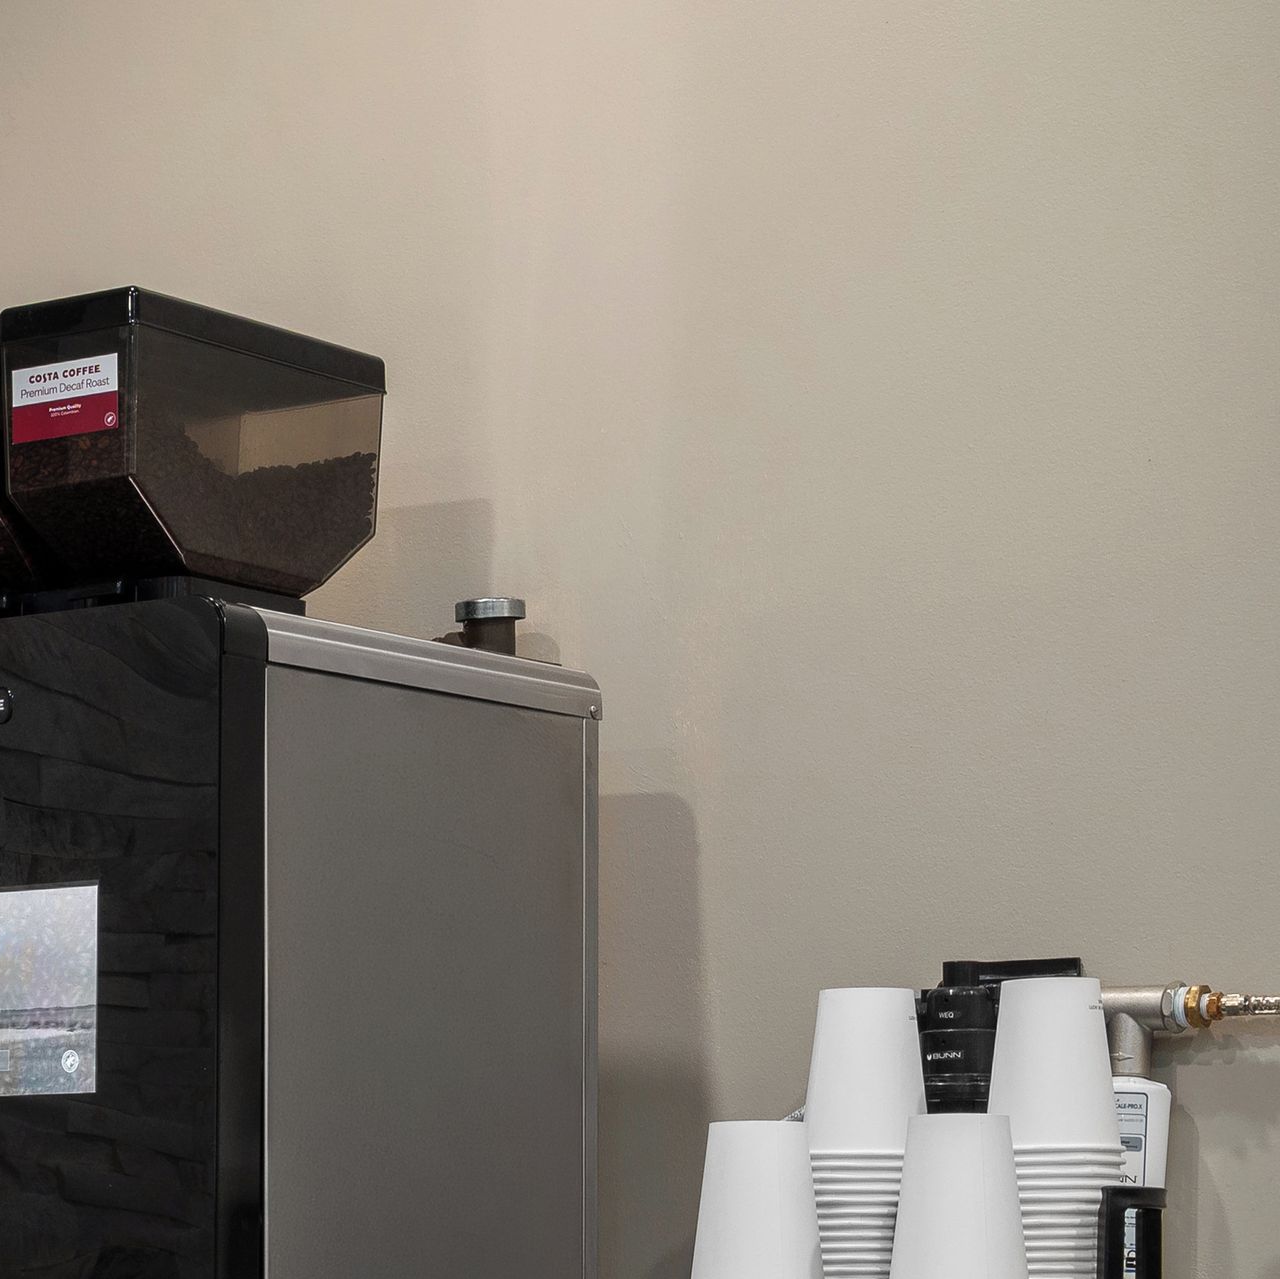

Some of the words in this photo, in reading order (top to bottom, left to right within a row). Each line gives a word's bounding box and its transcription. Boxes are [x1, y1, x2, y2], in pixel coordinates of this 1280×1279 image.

[29, 372, 60, 384] COSTA
[62, 364, 100, 378] COFFEE
[20, 386, 58, 399] Premium
[60, 379, 85, 393] Decaf
[86, 377, 110, 389] Roast
[932, 1052, 962, 1060] BUNN
